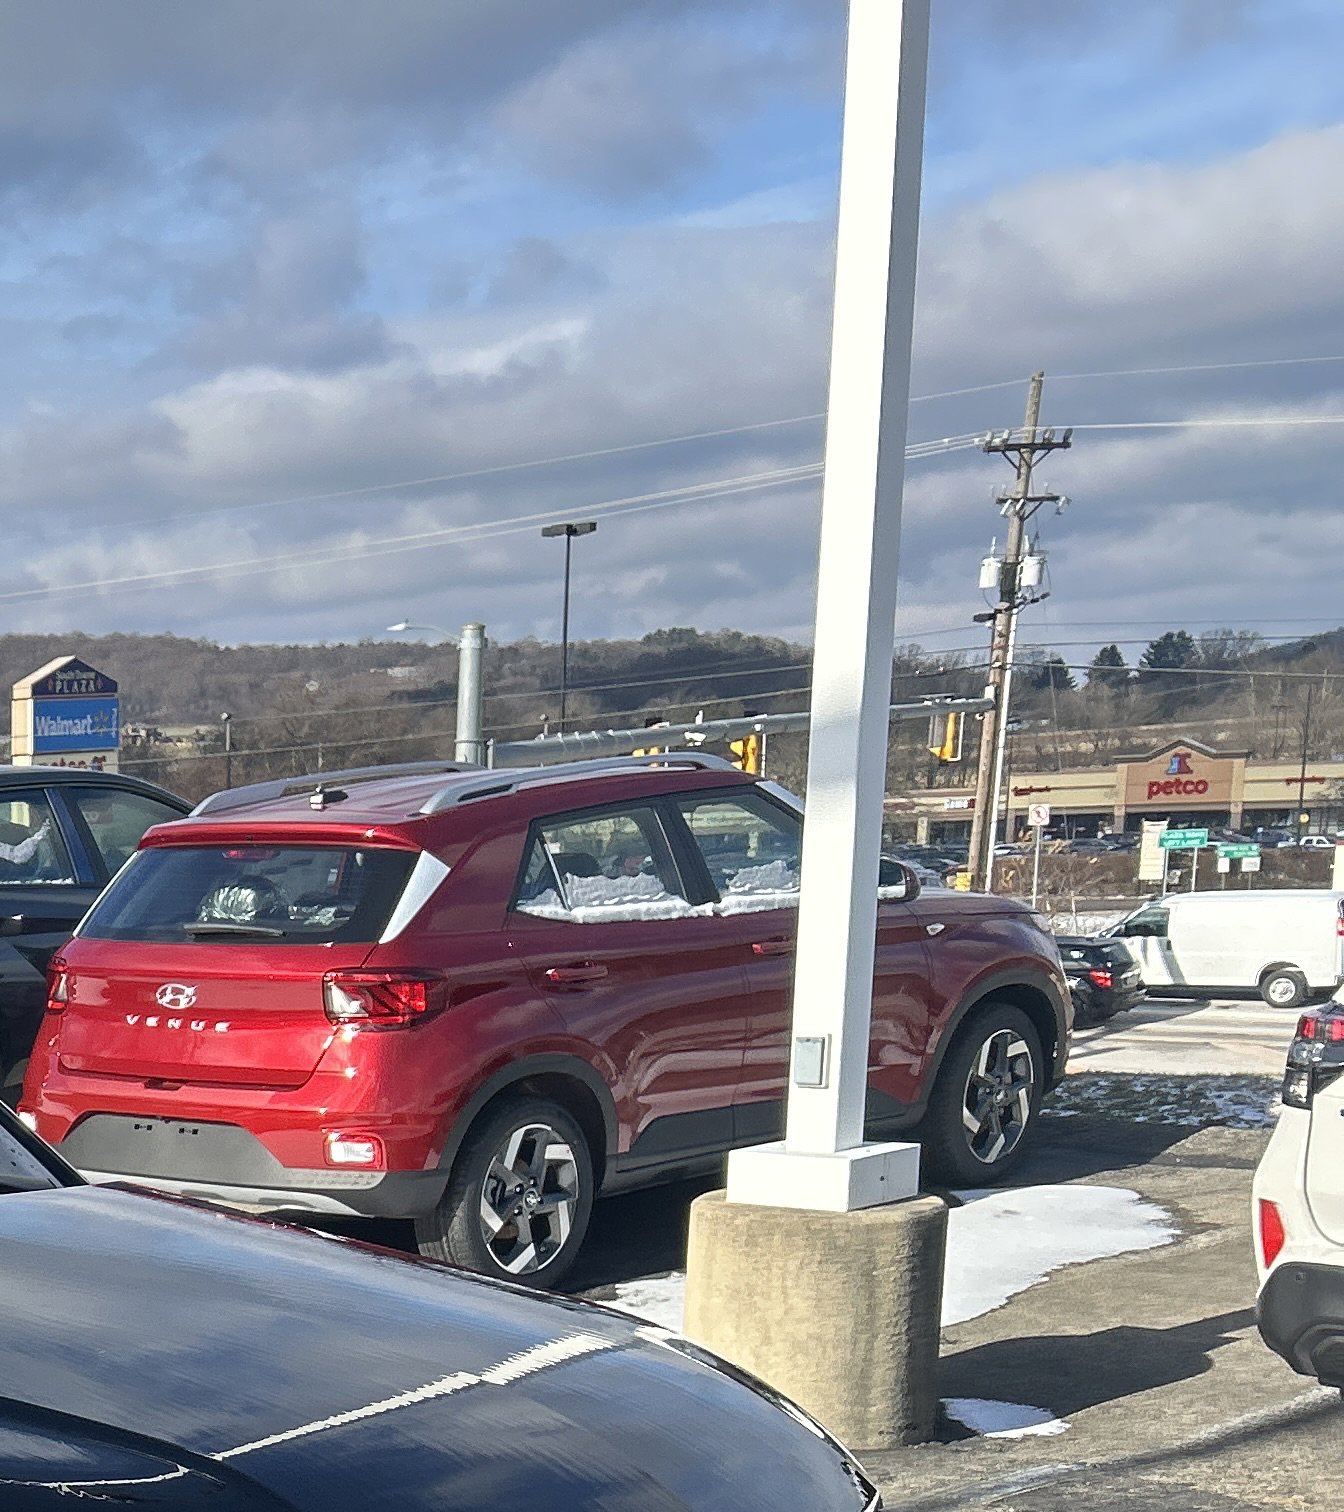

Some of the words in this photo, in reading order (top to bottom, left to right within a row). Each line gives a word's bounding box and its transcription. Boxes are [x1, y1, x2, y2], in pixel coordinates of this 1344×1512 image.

[55, 679, 96, 694] PLAZA
[35, 714, 92, 736] Walmart
[1147, 777, 1209, 800] petco
[126, 1013, 231, 1033] VENUE
